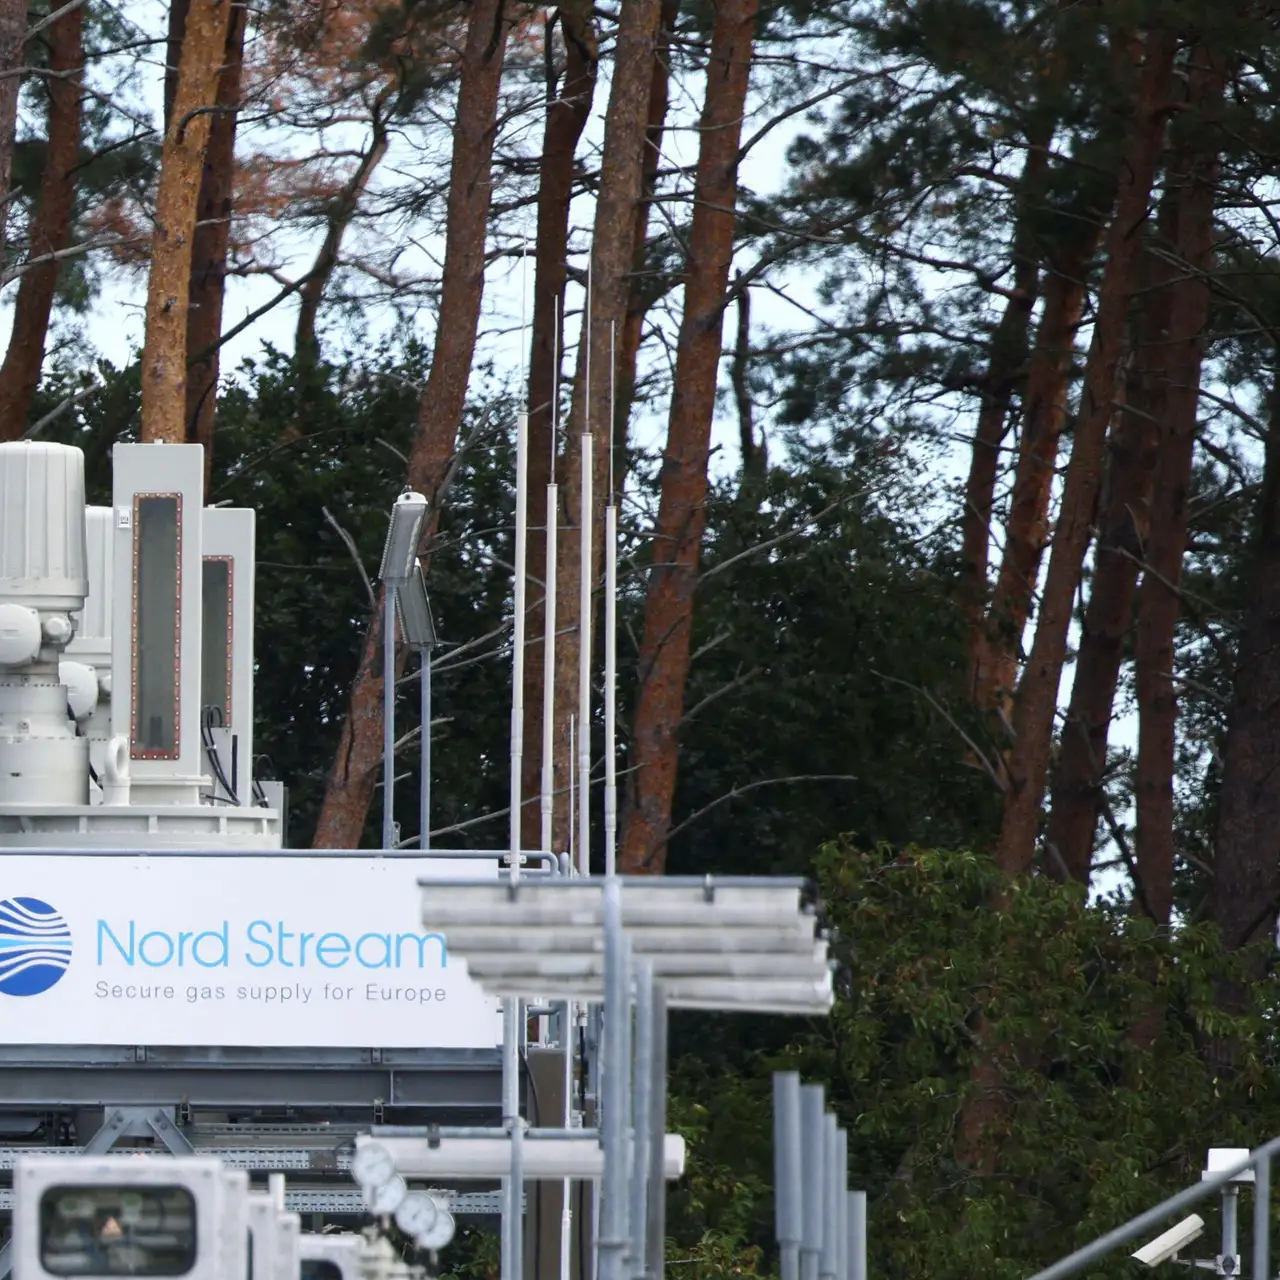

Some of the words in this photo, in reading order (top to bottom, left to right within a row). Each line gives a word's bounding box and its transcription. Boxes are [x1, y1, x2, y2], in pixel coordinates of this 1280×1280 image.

[96, 919, 229, 968] Nord
[244, 919, 448, 969] Stream
[95, 980, 175, 999] Secure
[186, 985, 226, 1003] gas
[237, 982, 313, 1004] supply
[324, 982, 354, 1001] for
[365, 983, 447, 1005] Europe
